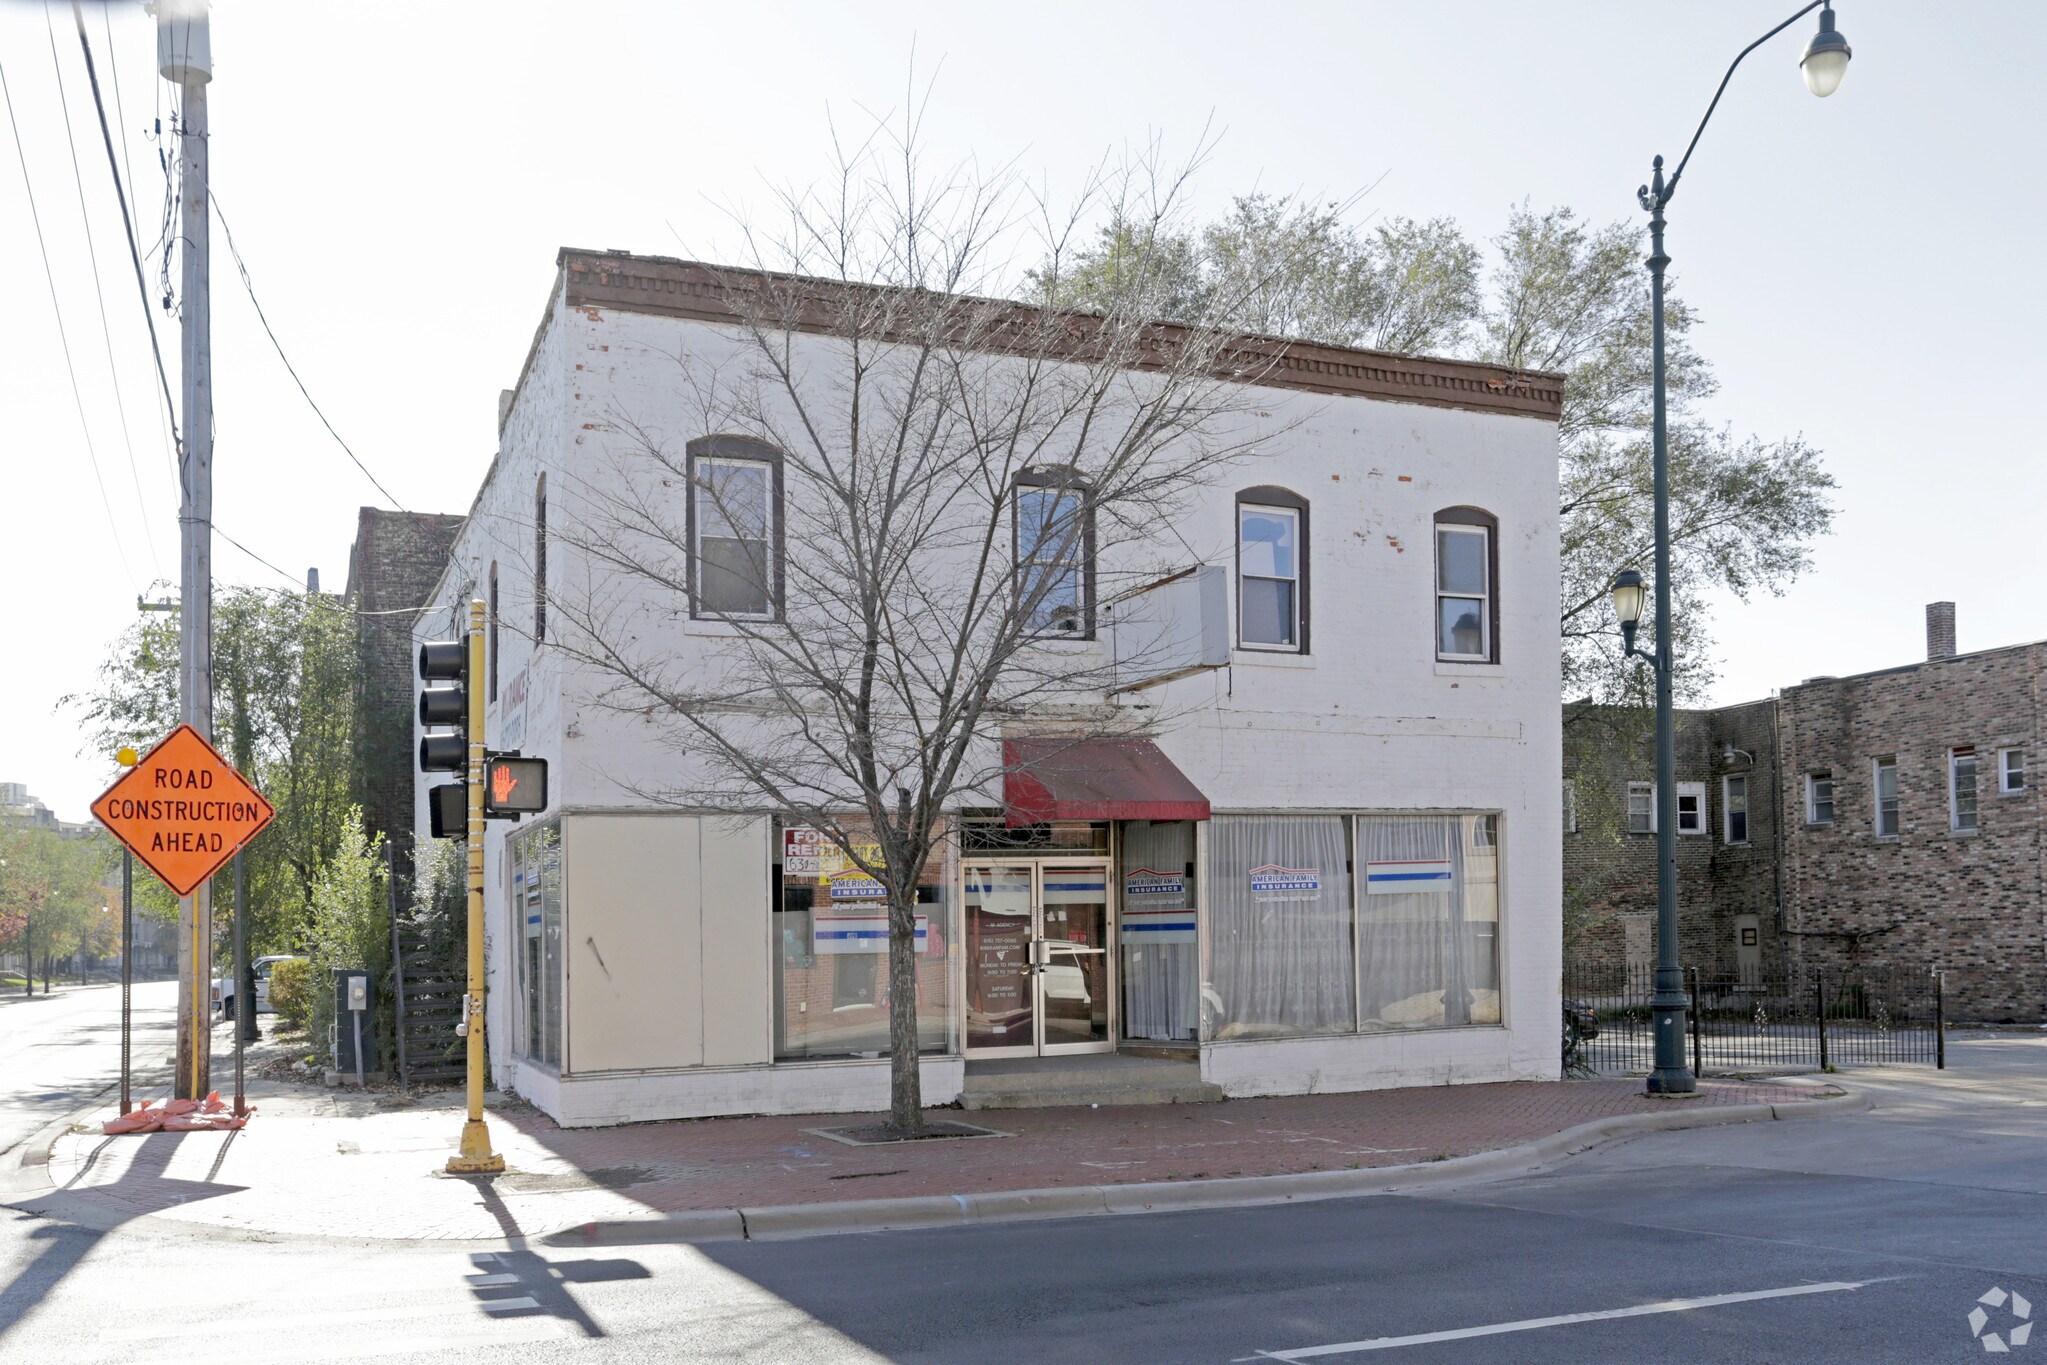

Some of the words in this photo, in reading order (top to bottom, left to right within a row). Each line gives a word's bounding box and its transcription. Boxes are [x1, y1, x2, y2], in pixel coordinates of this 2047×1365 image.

[155, 768, 213, 789] ROAD
[108, 799, 258, 822] CONSTRUCTION
[1119, 801, 1204, 820] BROADWAY
[151, 832, 223, 853] AHEAD
[787, 843, 840, 856] RENT
[831, 879, 879, 888] AMERICAN
